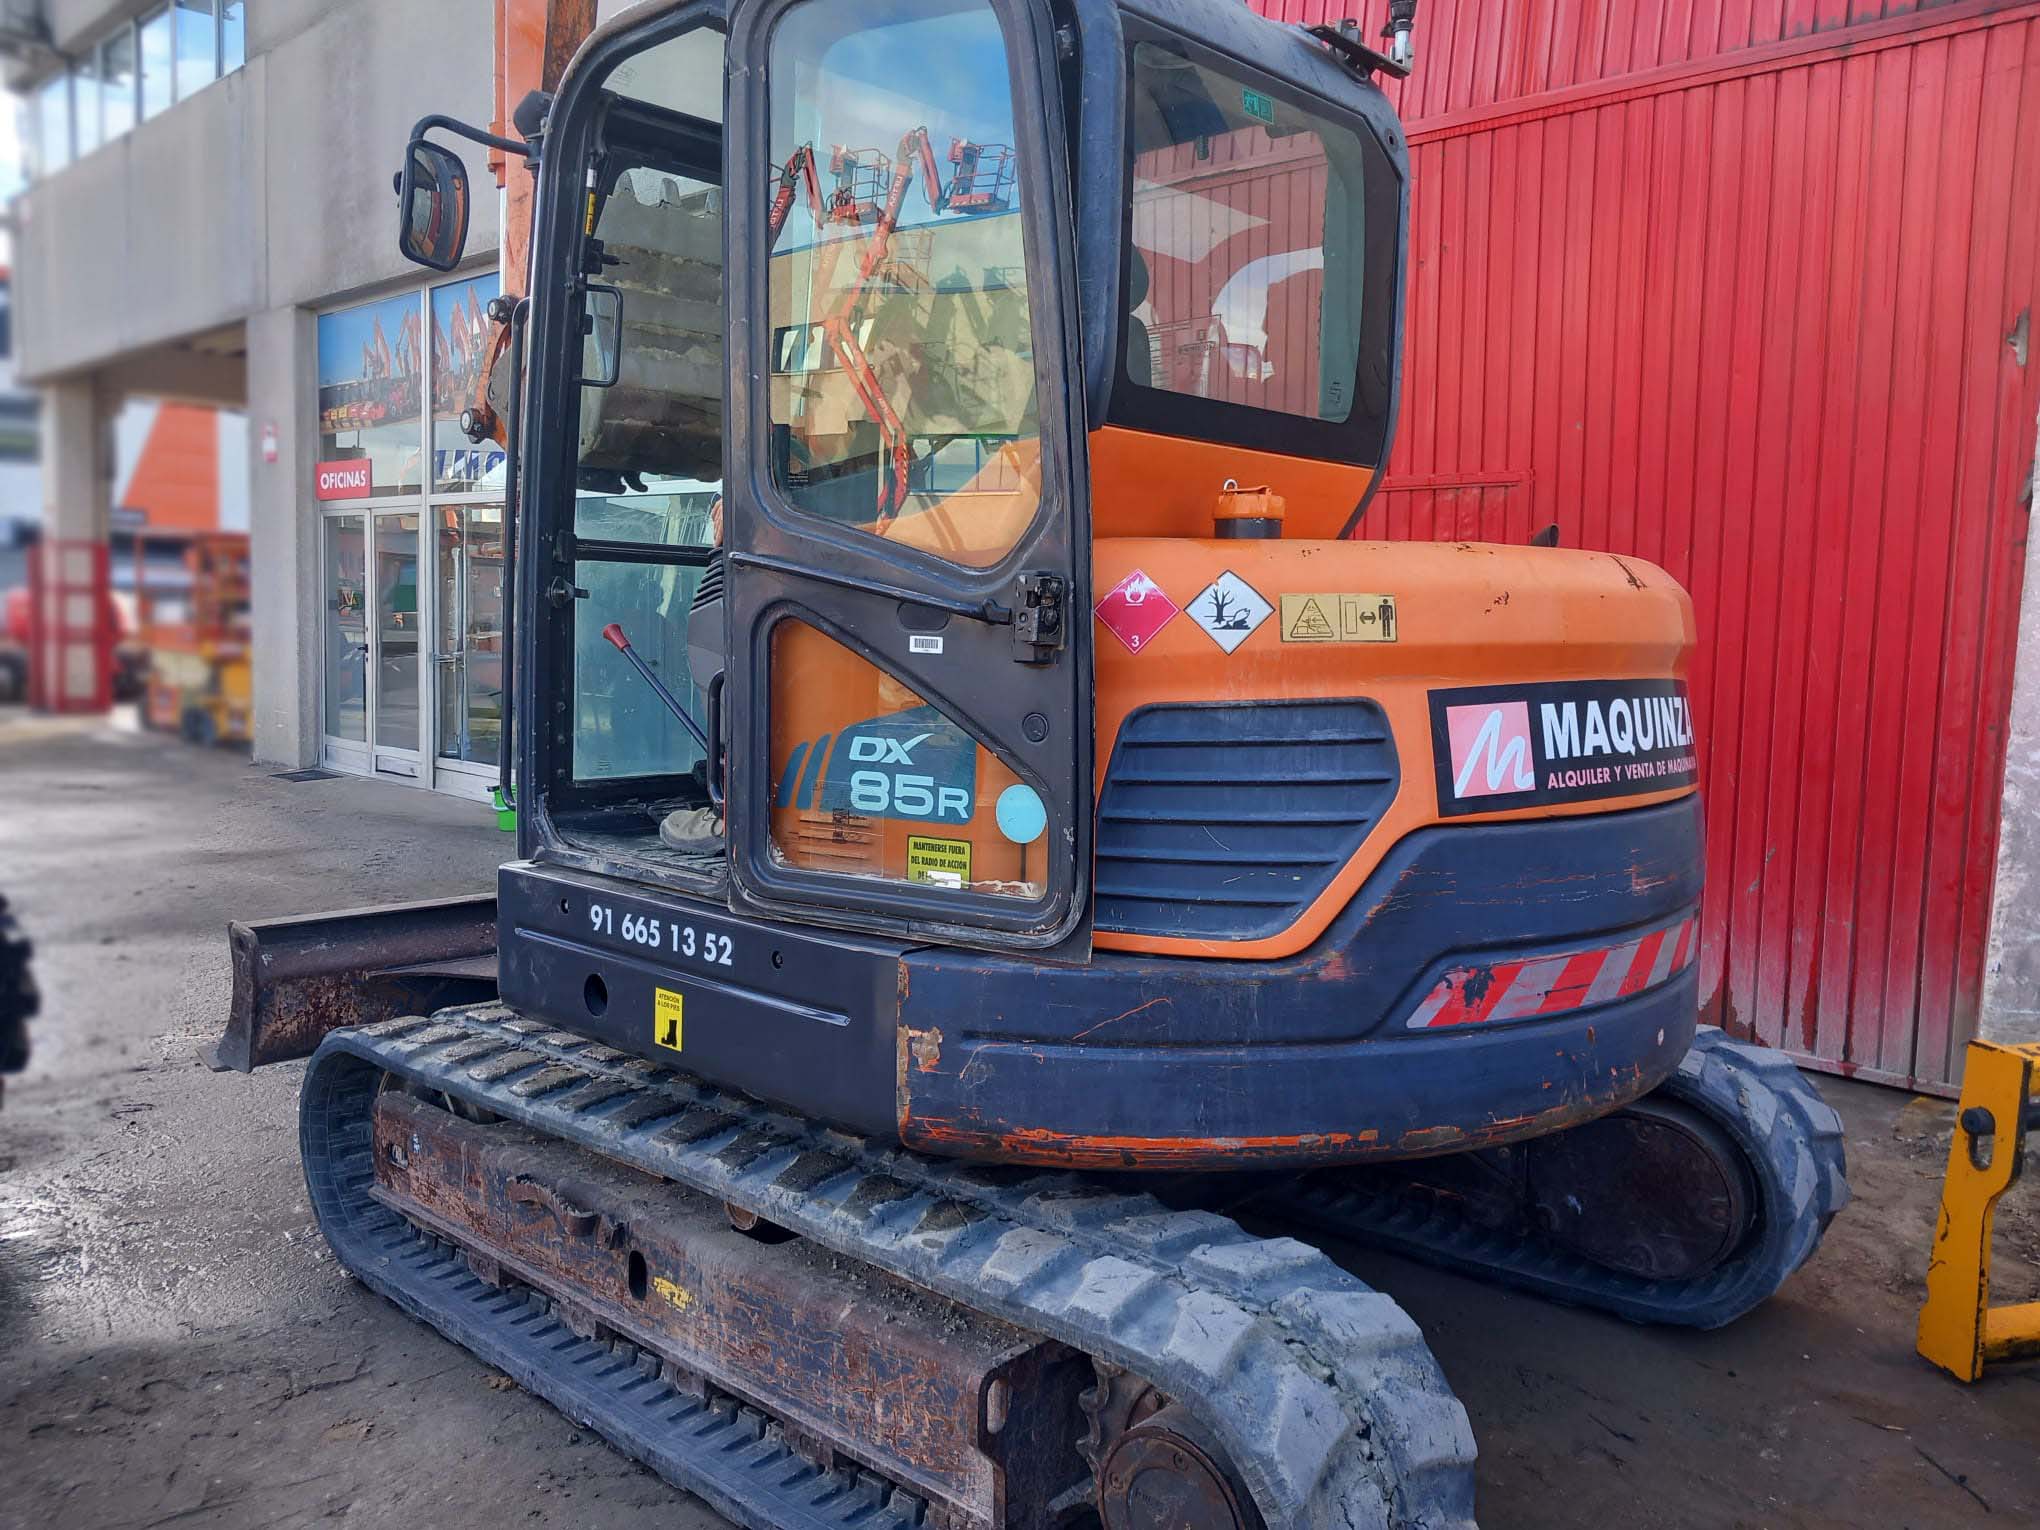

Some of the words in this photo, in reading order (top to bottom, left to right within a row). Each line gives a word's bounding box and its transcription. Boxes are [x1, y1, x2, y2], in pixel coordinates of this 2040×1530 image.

[320, 469, 367, 490] OFICINAS
[1130, 634, 1140, 648] 3
[1540, 696, 1694, 760] MAQUINZA
[848, 732, 935, 766] DX
[1547, 767, 1612, 790] ALQUILER
[1614, 765, 1622, 782] Y
[1624, 761, 1656, 780] VENTA
[1656, 760, 1667, 777] DE
[850, 770, 969, 819] 85R
[910, 855, 921, 865] DEL
[921, 856, 939, 867] RADIO
[939, 858, 947, 868] DE
[912, 841, 947, 853] MANTENERSE
[948, 845, 966, 856] FUERA
[590, 904, 612, 935] 91
[621, 913, 661, 948] 665
[670, 924, 696, 957] 13
[703, 932, 733, 966] 52
